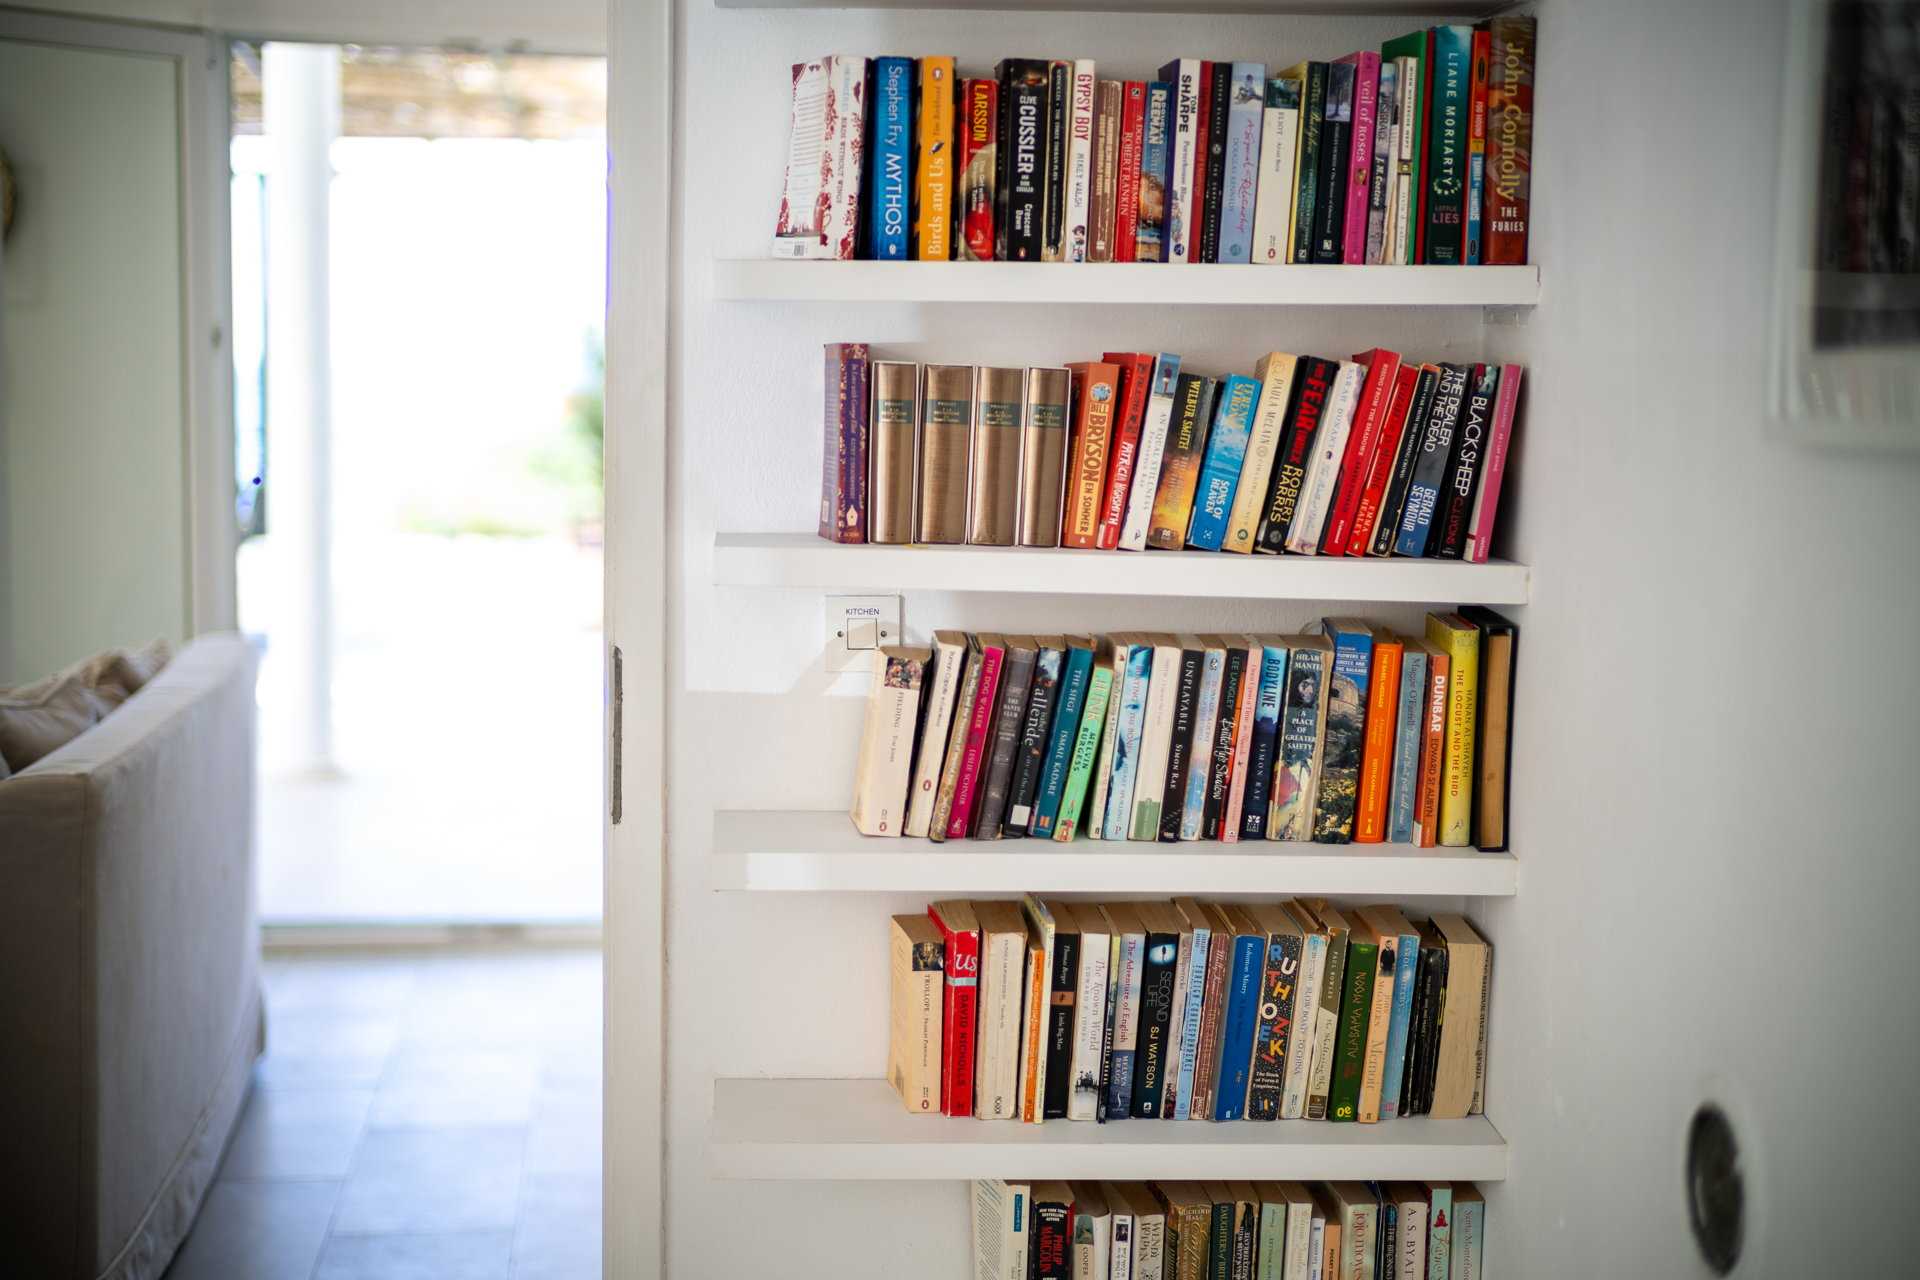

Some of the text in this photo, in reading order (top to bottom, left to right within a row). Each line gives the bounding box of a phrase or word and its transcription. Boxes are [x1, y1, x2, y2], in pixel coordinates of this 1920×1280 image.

[973, 84, 988, 141] LARSSON
[1075, 74, 1092, 140] GYPSY BOY
[1149, 90, 1167, 144] REEMAN
[1180, 75, 1191, 133] SHARPE
[1441, 53, 1458, 185] LIANE MORIARTY
[1497, 42, 1523, 200] John Connolly
[886, 65, 902, 235] Stephen Fry MYTHOS
[1018, 105, 1036, 172] CUSSLER
[1133, 143, 1142, 178] CALLED
[1121, 132, 1132, 215] ROBERT RANKIN
[928, 158, 943, 255] Birds and Us
[1024, 204, 1032, 236] Crescent
[1129, 180, 1139, 236] DEMOLITION
[1492, 222, 1524, 231] FURIES
[1500, 207, 1518, 217] THE
[1090, 404, 1109, 413] BILL
[1178, 381, 1200, 450] WILBUR SMITH
[1269, 378, 1284, 407] PAULA
[1296, 379, 1326, 432] FEAR
[1358, 364, 1389, 456] RISING FROM THE SHADOWS
[1424, 367, 1452, 452] AND THE DEAD
[1438, 372, 1465, 445] THE DEALER
[1455, 396, 1487, 496] BLACK SHEEP
[1080, 414, 1107, 532] BRYSON EN SOMMER
[1108, 442, 1133, 525] PATRICIA HIGHSMITH
[1205, 478, 1220, 514] HEAVEN
[1270, 465, 1291, 523] HARRIS
[1281, 467, 1303, 525] ROBERT
[1213, 481, 1229, 520] SONS OF
[1353, 498, 1369, 536] HEALEY
[1362, 505, 1374, 533] EMMA
[1403, 485, 1424, 532] SEYMOUR
[1418, 488, 1436, 525] GERALD
[975, 659, 995, 728] THE DOG WALKER
[1066, 670, 1082, 712] THE SIEGE
[1178, 661, 1194, 732] UNPLAYABLE
[1227, 656, 1240, 709] LEE LANGLEY
[1262, 659, 1280, 708] BODYLINE
[1456, 669, 1464, 686] THE
[894, 692, 904, 728] FIELDING
[1025, 688, 1046, 747] allende
[1292, 718, 1314, 726] PLACE
[1431, 676, 1445, 732] DUNBAR
[1455, 691, 1463, 726] LOCUST
[1463, 689, 1473, 723] HANAN
[967, 749, 976, 770] LESLIE
[1048, 731, 1068, 795] ISMAIL KADARE
[1073, 727, 1089, 772] BURGESS
[1082, 732, 1097, 769] MELVIN
[1213, 718, 1234, 799] Butterfly's Shadow
[1429, 739, 1440, 774] EDWARD
[1453, 730, 1461, 751] AND
[1253, 743, 1265, 801] SIMON RAE
[1451, 775, 1459, 797] BIRD
[1425, 787, 1434, 817] AUBYN
[955, 954, 977, 970] Us
[1062, 945, 1070, 965] Thomas
[1089, 960, 1105, 1051] The Known World
[1120, 940, 1136, 1043] The Adventure of English
[1146, 985, 1158, 1007] LIFE
[1157, 970, 1172, 1022] SECOND
[1240, 974, 1250, 995] Mistry
[1184, 965, 1203, 1073] FOREIGN CORRESPONDENCE
[1346, 971, 1366, 1058] ALABAMA MOON
[957, 994, 968, 1087] DAVID NICHOLLS
[1145, 1026, 1159, 1088] SJ WATSON
[1114, 1057, 1122, 1085] BRAGG
[1121, 1055, 1129, 1086] MELVYN
[1366, 1040, 1384, 1091] Memoir
[1220, 1207, 1228, 1251] DAUGHTERS
[1352, 1212, 1368, 1237] jojo
[1407, 1225, 1416, 1235] S.
[1408, 1208, 1416, 1220] A.
[1464, 1210, 1472, 1232] Santa
[1140, 1223, 1150, 1262] HOLDEN
[1151, 1223, 1161, 1257] WENDY
